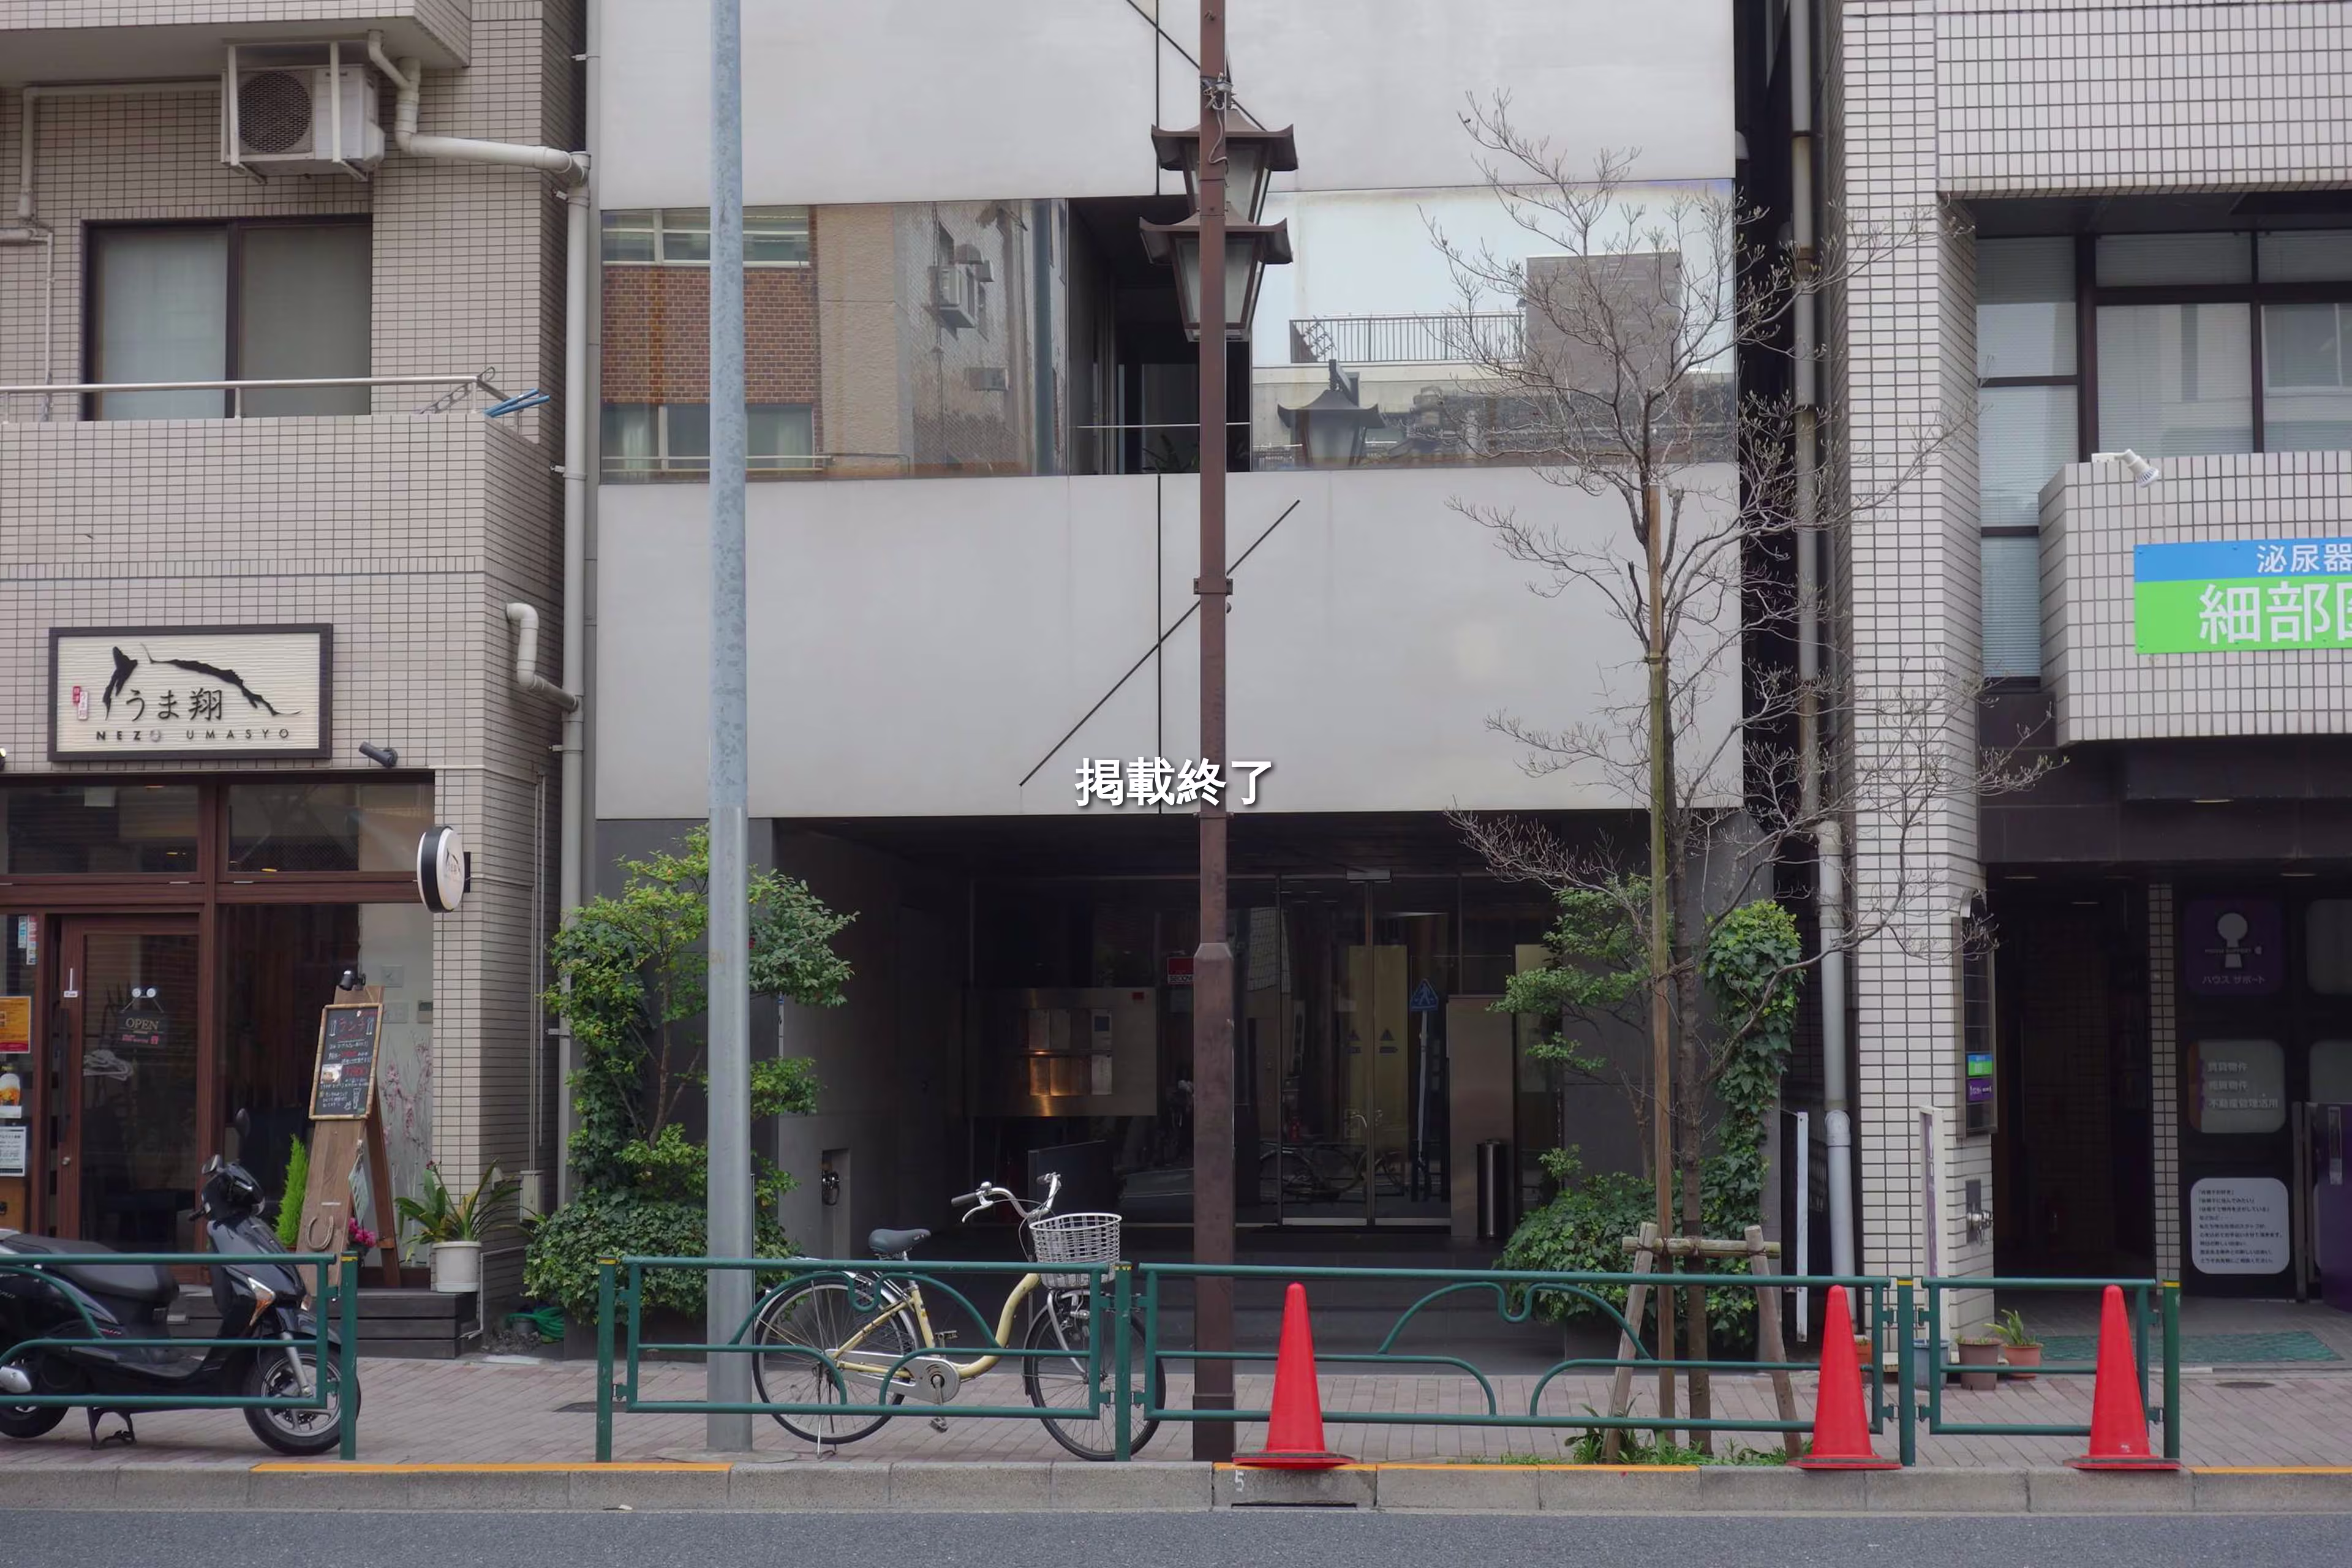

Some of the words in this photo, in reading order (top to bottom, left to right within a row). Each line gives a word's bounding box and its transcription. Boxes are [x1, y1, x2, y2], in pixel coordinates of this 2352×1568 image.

[2199, 581, 2352, 644] 細部
[126, 688, 222, 722] うま翔
[187, 729, 289, 739] UMASYO
[2202, 975, 2230, 984] ハウス
[126, 1017, 159, 1031] OPEN
[1235, 1469, 1244, 1491] 5
